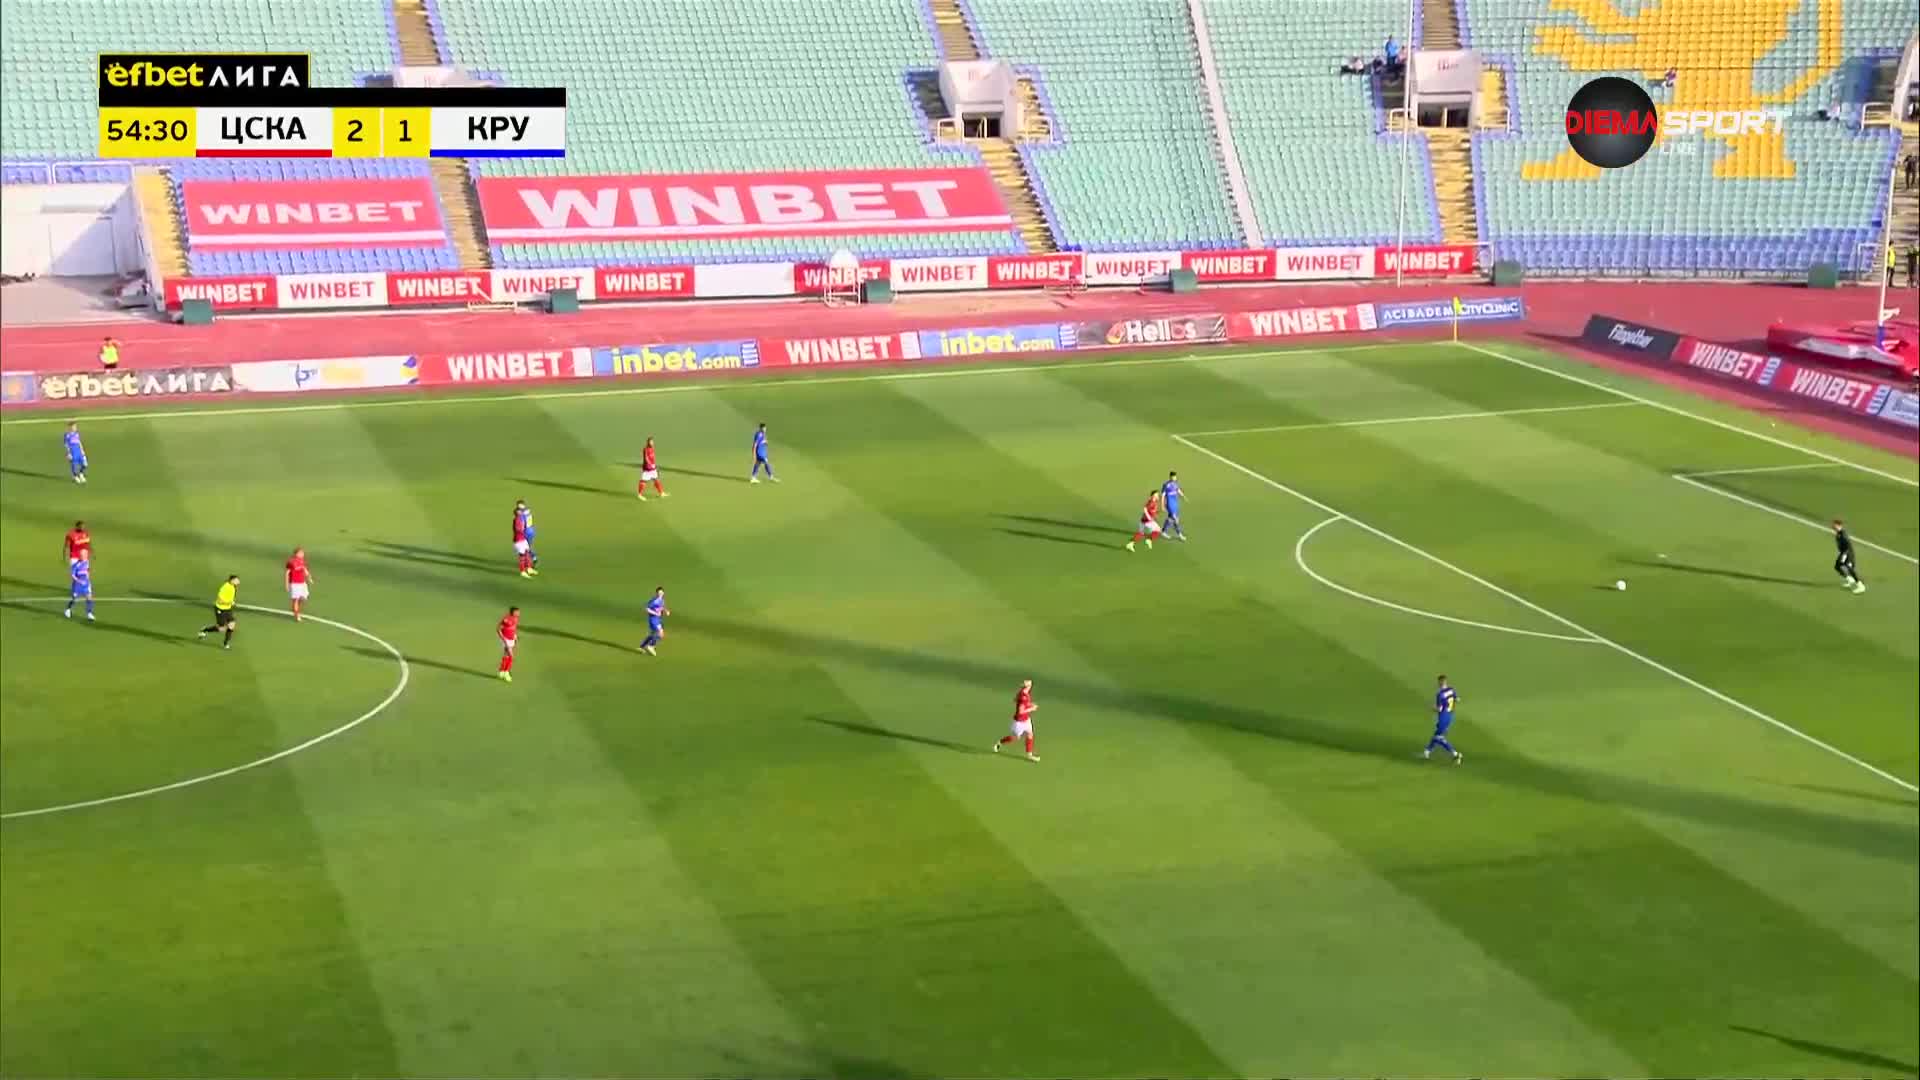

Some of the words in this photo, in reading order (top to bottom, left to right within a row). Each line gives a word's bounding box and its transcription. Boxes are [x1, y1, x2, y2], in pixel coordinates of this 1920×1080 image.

[200, 200, 423, 225] WINBET
[518, 178, 957, 229] WINBET
[997, 260, 1073, 281] WINBET
[1191, 256, 1268, 276] WINBET
[1287, 253, 1363, 272] WINBET
[1383, 251, 1465, 270] WINBET
[604, 272, 686, 293] WINBET
[902, 264, 977, 283] WINBET
[176, 281, 267, 304] WINBET
[290, 280, 375, 299] WINBET
[396, 274, 482, 298] WINBET
[1249, 308, 1349, 337] WINBET
[785, 335, 892, 365] WINBET
[940, 329, 1056, 356] inbet.com
[448, 352, 563, 381] WINBET
[612, 346, 742, 374] inbet.com
[1688, 341, 1764, 380] WINBET
[143, 371, 232, 394] ЛИГА
[1790, 367, 1873, 409] WINBET
